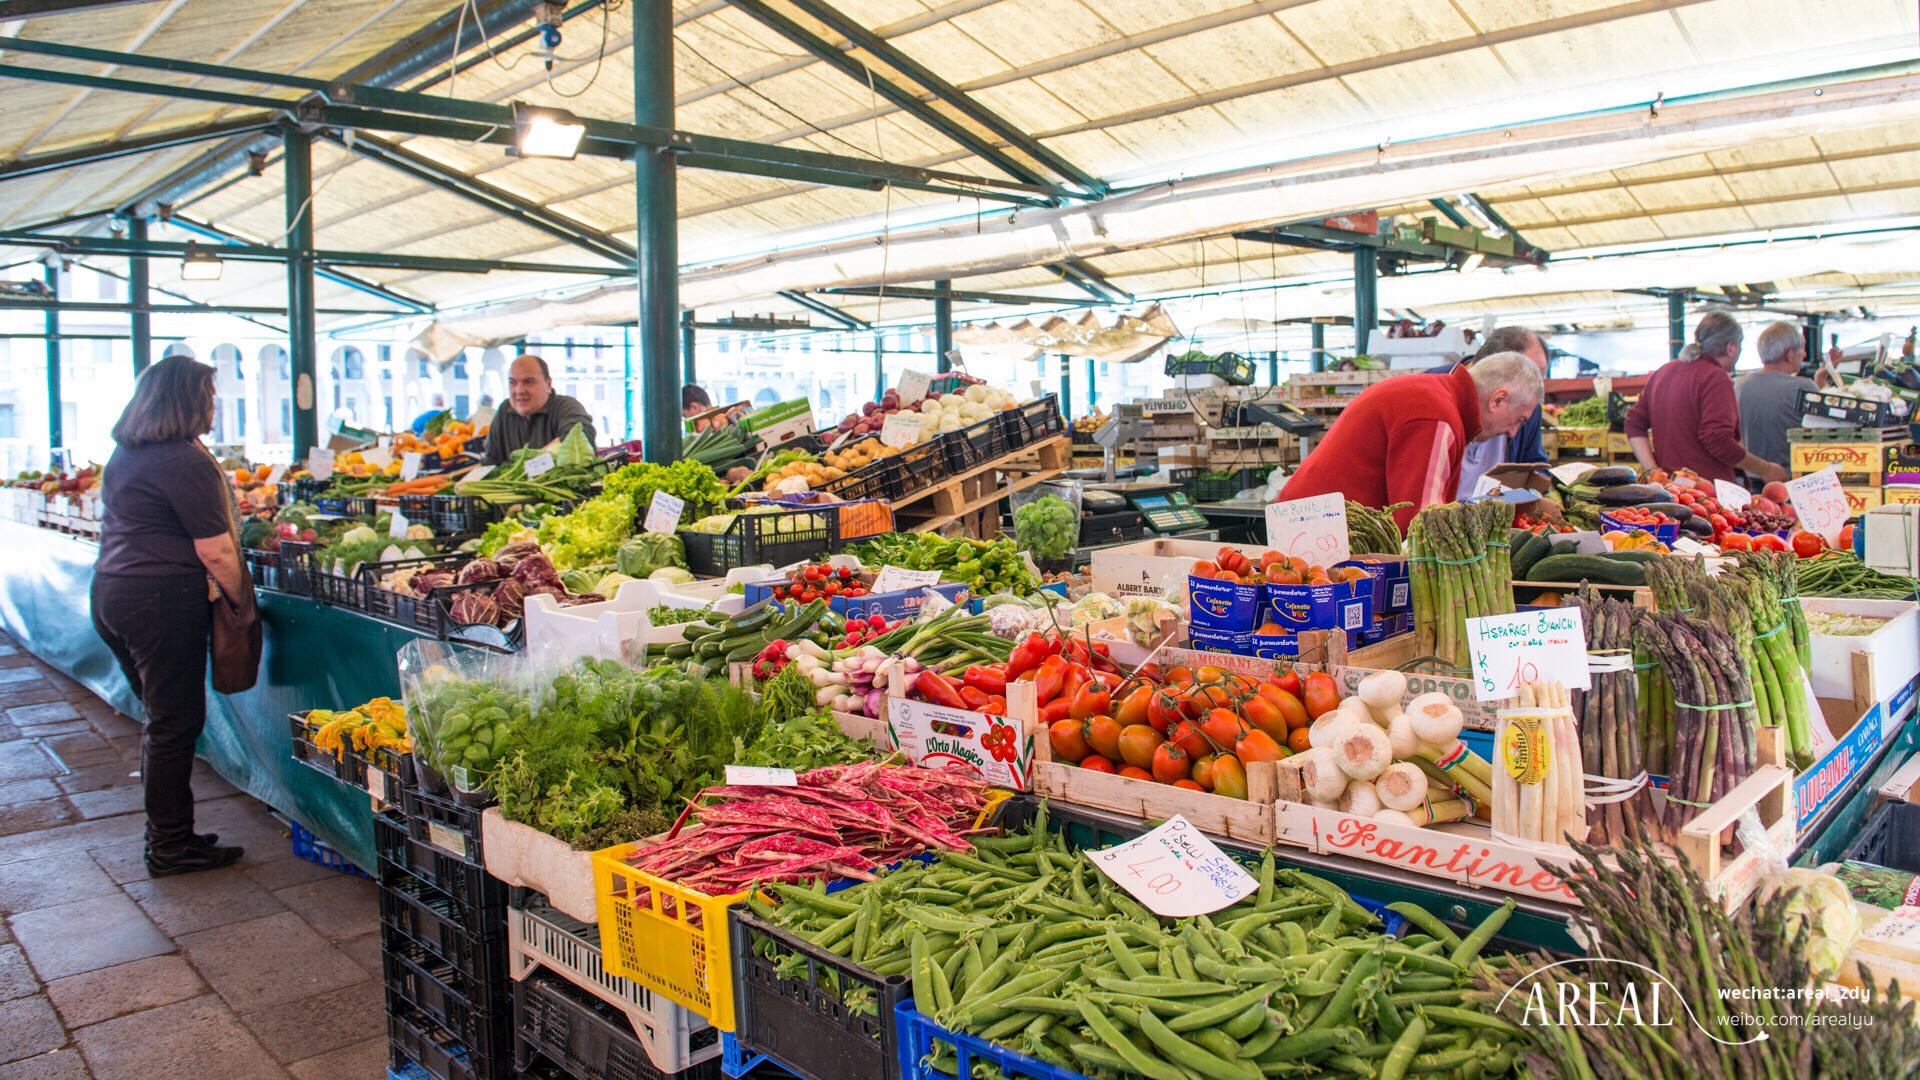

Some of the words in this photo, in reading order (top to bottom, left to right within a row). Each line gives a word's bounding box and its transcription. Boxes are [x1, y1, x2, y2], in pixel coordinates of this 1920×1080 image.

[1803, 446, 1868, 467] RECCHIA
[1117, 583, 1142, 593] ALBERT
[1195, 583, 1233, 593] pomodoro
[1273, 588, 1309, 596] pomodoro
[1205, 596, 1233, 606] Cofanetto
[1284, 602, 1311, 611] Cofanetto
[1479, 617, 1531, 642] ASPARAGI
[1537, 611, 1577, 634] BIANCHI
[1197, 653, 1251, 670] MUSIANI
[1506, 656, 1539, 690] 10
[925, 736, 950, 754] L'Orto
[951, 737, 984, 767] Magico
[1514, 733, 1528, 770] Fantin
[1800, 745, 1851, 821] LUCANA
[1164, 820, 1205, 860] PISELLI
